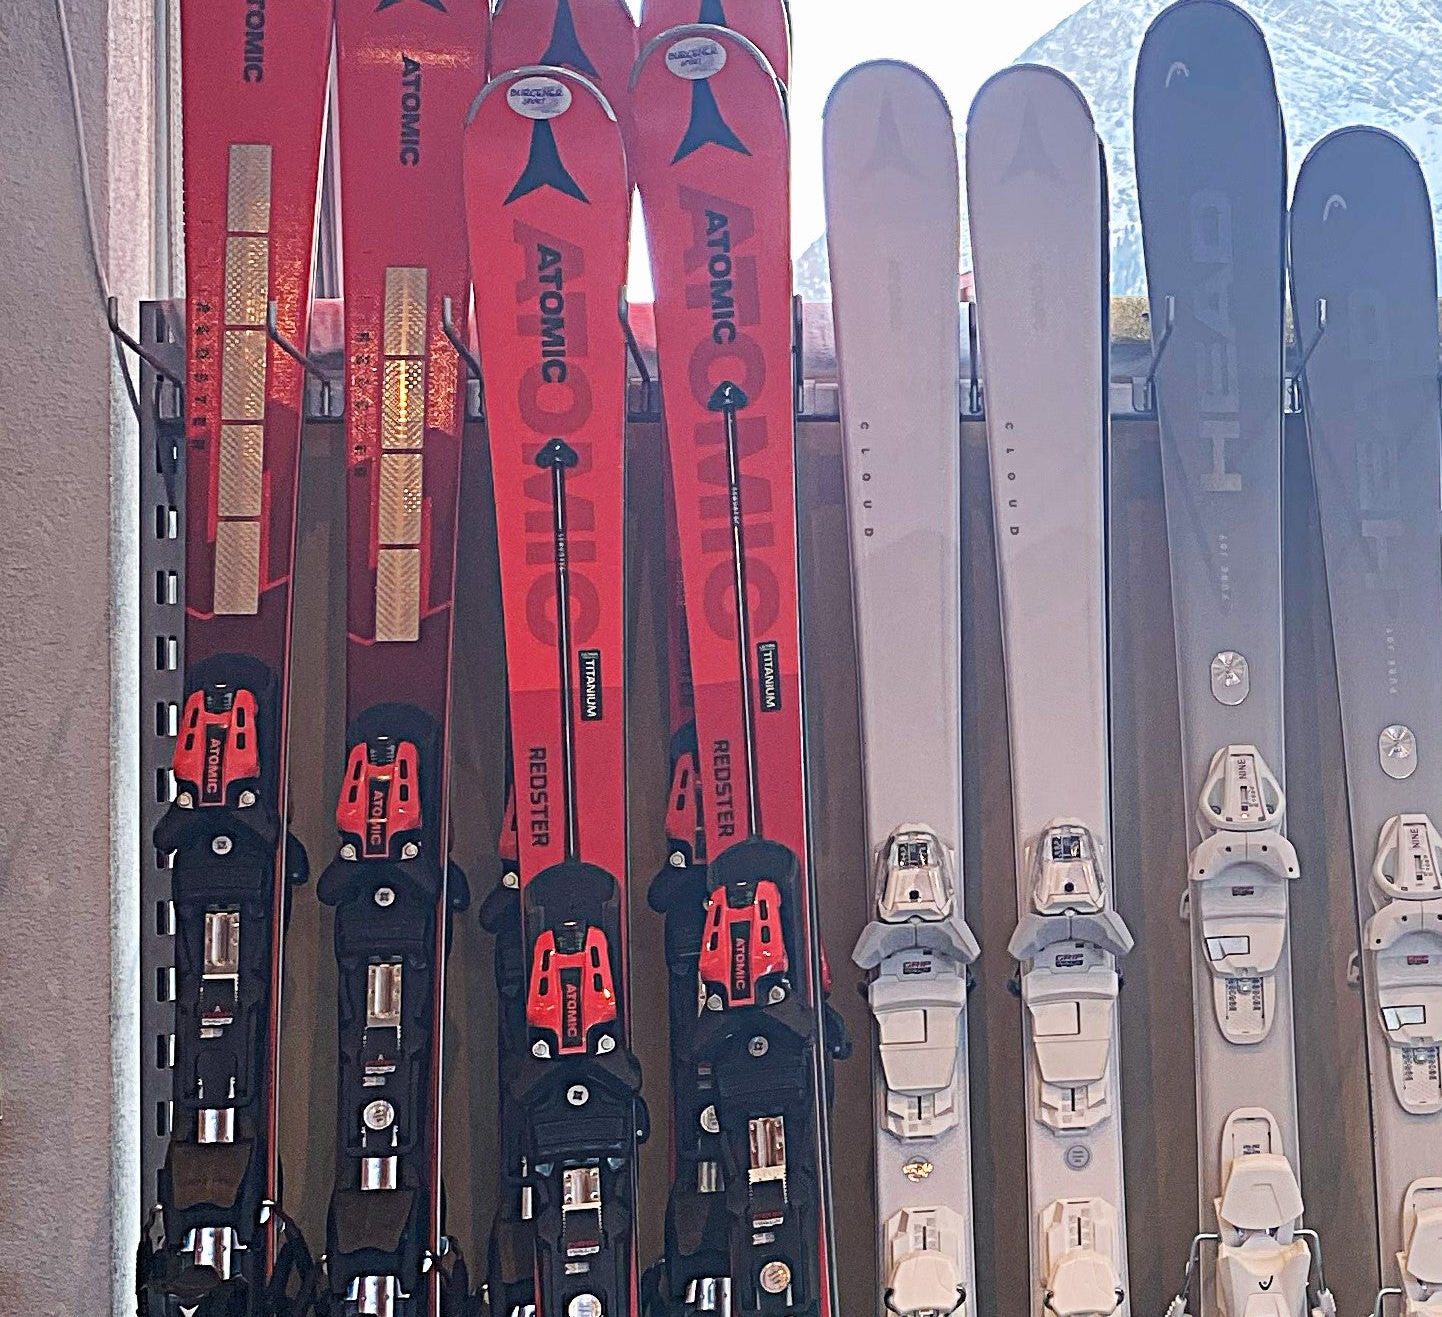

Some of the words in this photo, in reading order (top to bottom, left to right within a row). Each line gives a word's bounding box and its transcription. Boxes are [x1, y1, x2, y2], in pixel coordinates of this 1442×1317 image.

[399, 52, 422, 167] ATOMIC
[704, 207, 736, 345] ATOMIC
[536, 241, 568, 385] ATOMIC
[859, 420, 874, 538] CLOUD
[1004, 420, 1020, 537] CLOUD
[585, 659, 598, 718] TITANIUM
[763, 650, 776, 709] TITANIUM
[206, 737, 221, 795] ATOMIC
[713, 739, 734, 838] REDSTER
[1237, 758, 1247, 780] NINE
[371, 789, 384, 847] ATOMIC
[529, 746, 550, 847] REDSTER
[1410, 827, 1421, 849] NINE
[735, 937, 747, 991] ATOMIC
[566, 983, 578, 1039] ATOMIC
